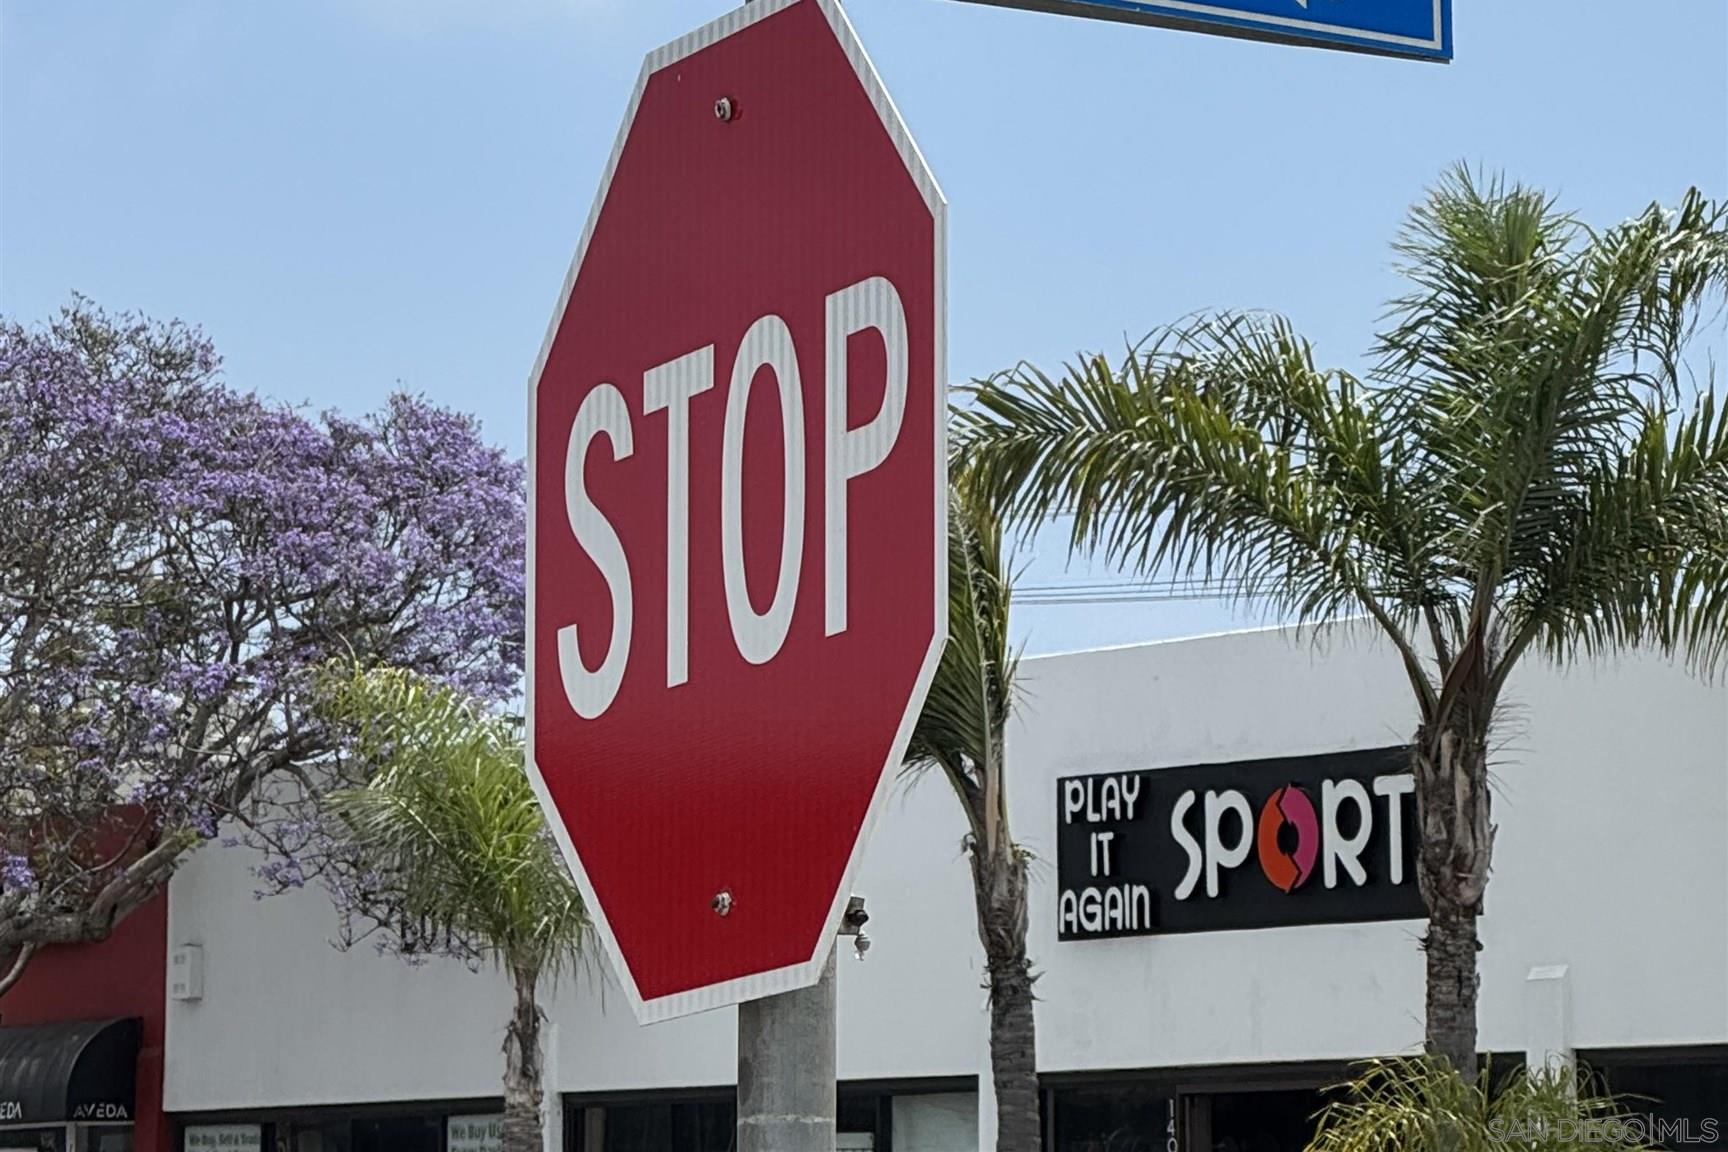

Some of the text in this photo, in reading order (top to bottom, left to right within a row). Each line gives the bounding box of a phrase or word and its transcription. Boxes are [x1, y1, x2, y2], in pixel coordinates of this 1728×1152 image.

[557, 276, 909, 720] STOP
[1065, 775, 1140, 824] PLAY
[1091, 832, 1114, 876] IT
[1059, 884, 1150, 934] AGAIN
[73, 1103, 128, 1118] AVEDA
[468, 1124, 486, 1142] Buy
